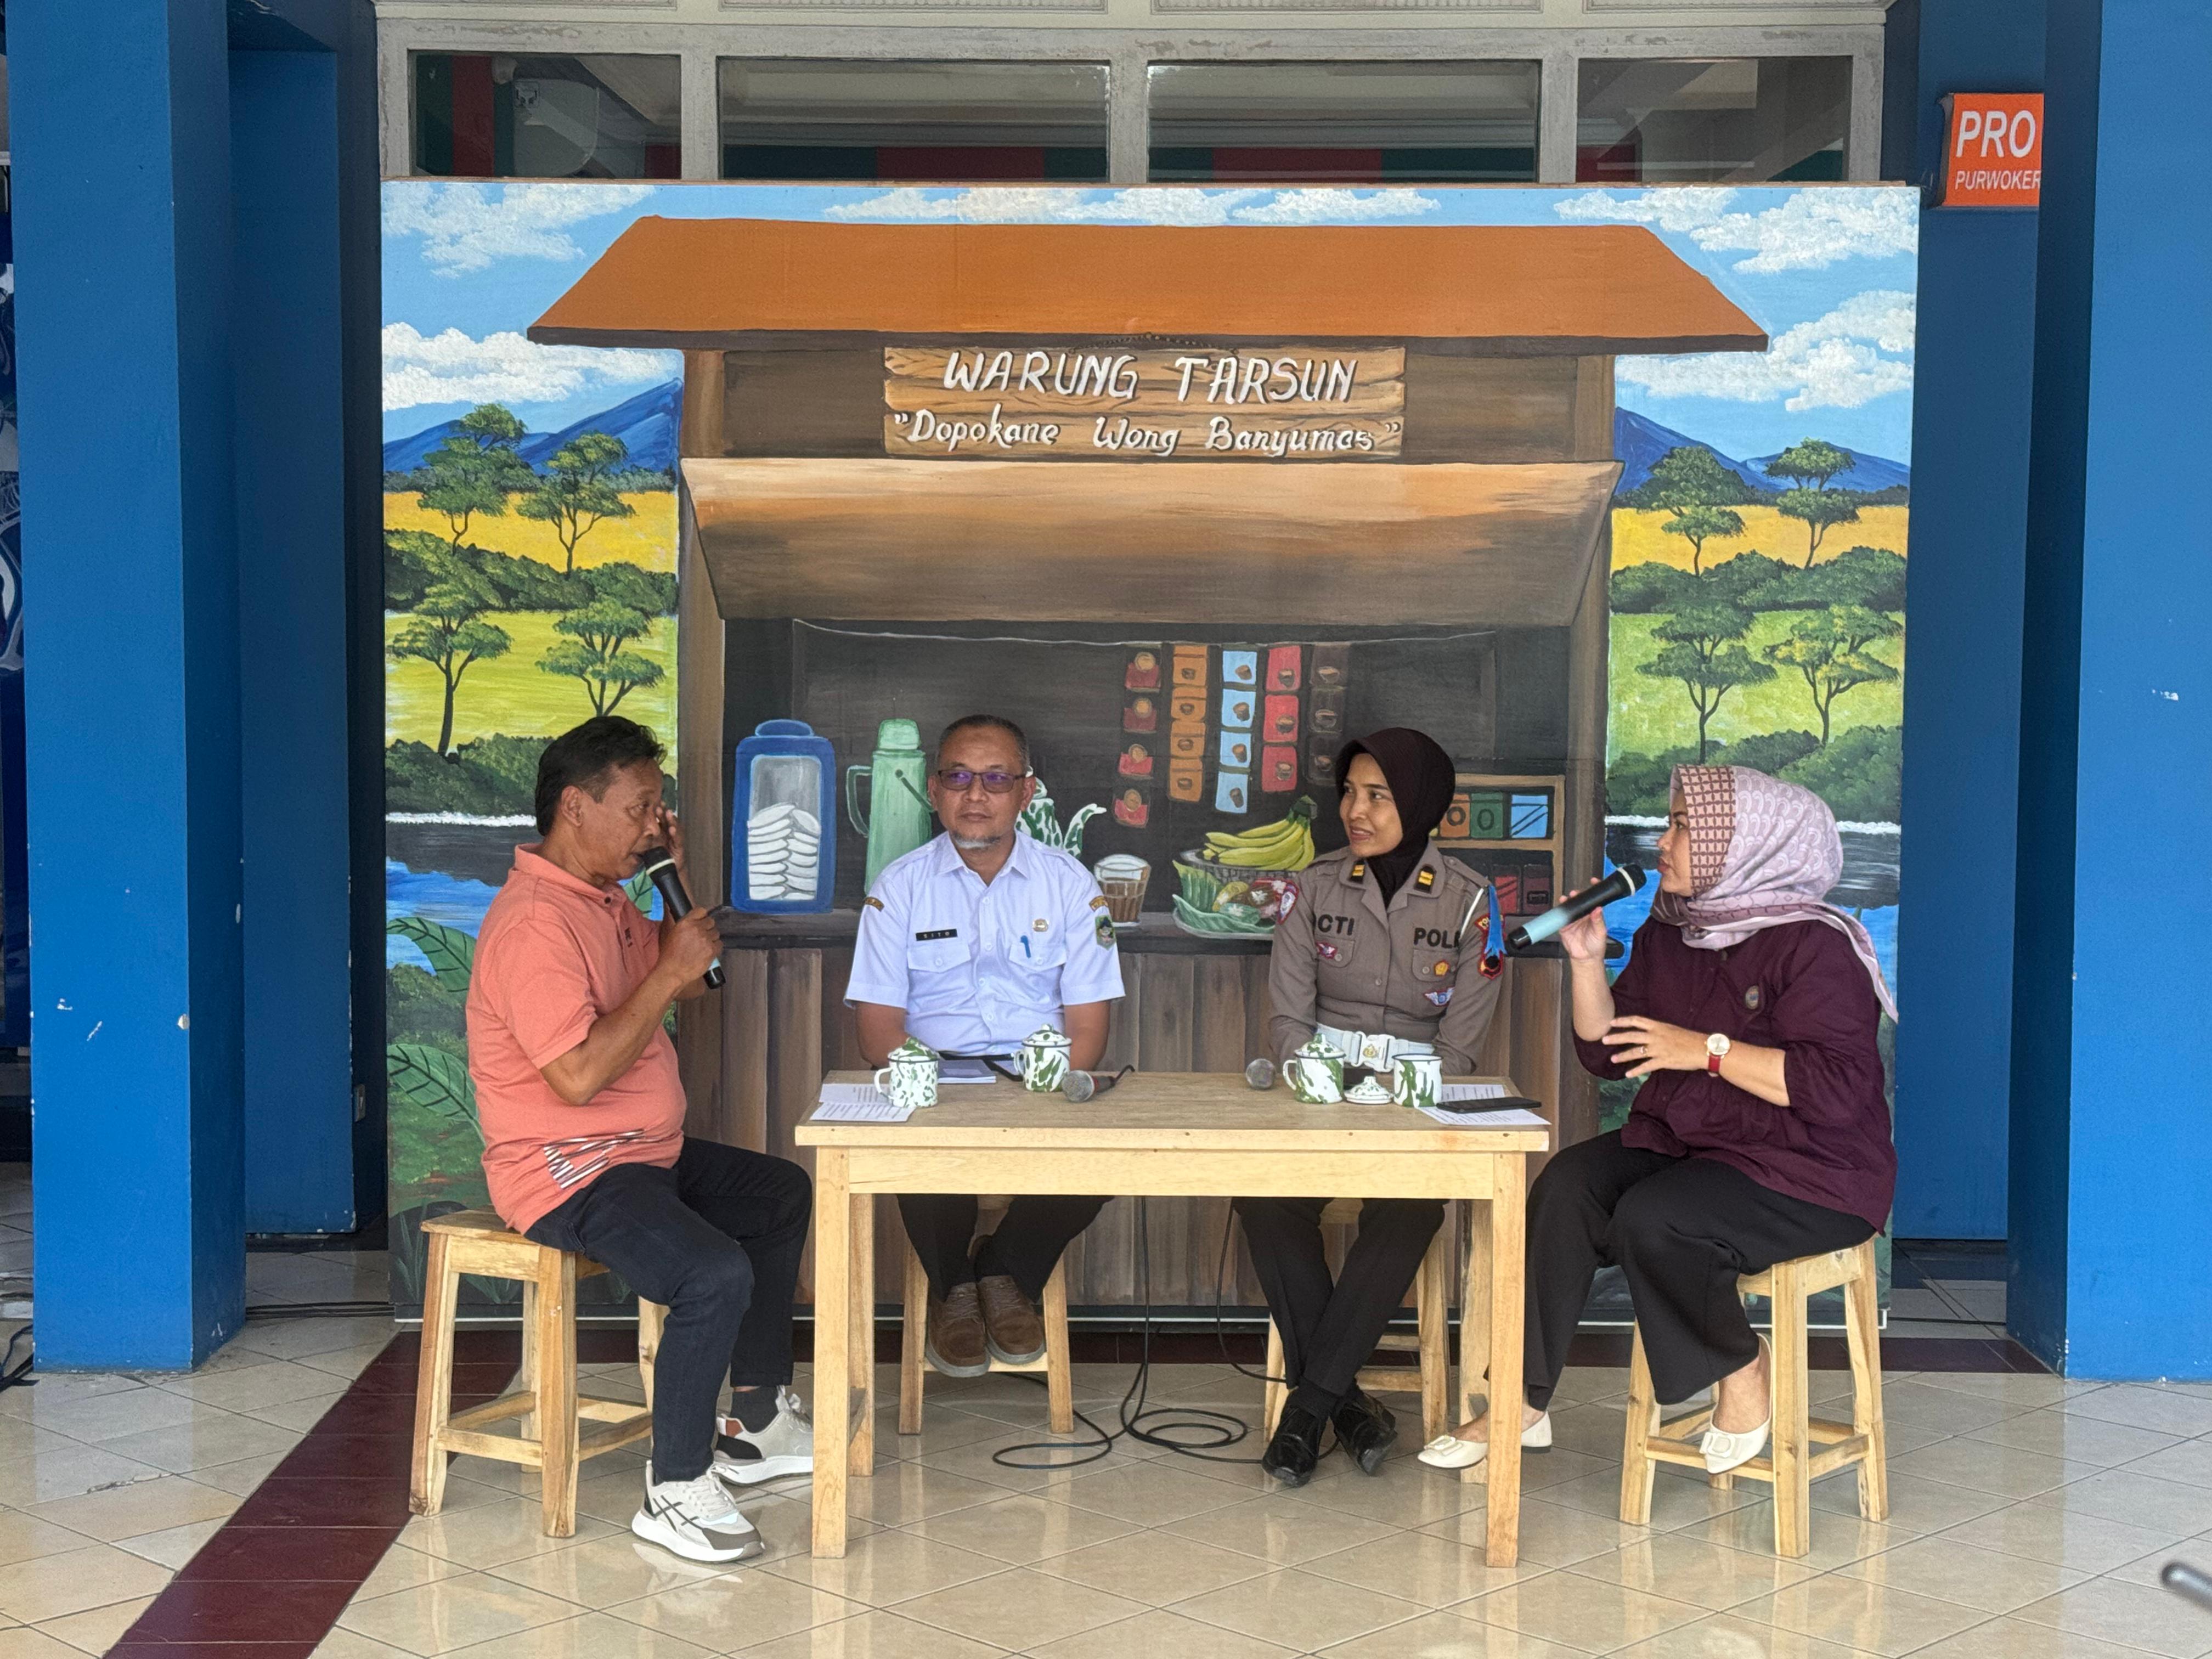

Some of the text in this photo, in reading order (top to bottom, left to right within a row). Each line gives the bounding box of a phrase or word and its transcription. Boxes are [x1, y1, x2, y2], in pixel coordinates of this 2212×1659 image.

[1956, 110, 2036, 158] PRO
[943, 351, 1358, 404] WARUNG TARSUN
[1093, 416, 1181, 456] Wong
